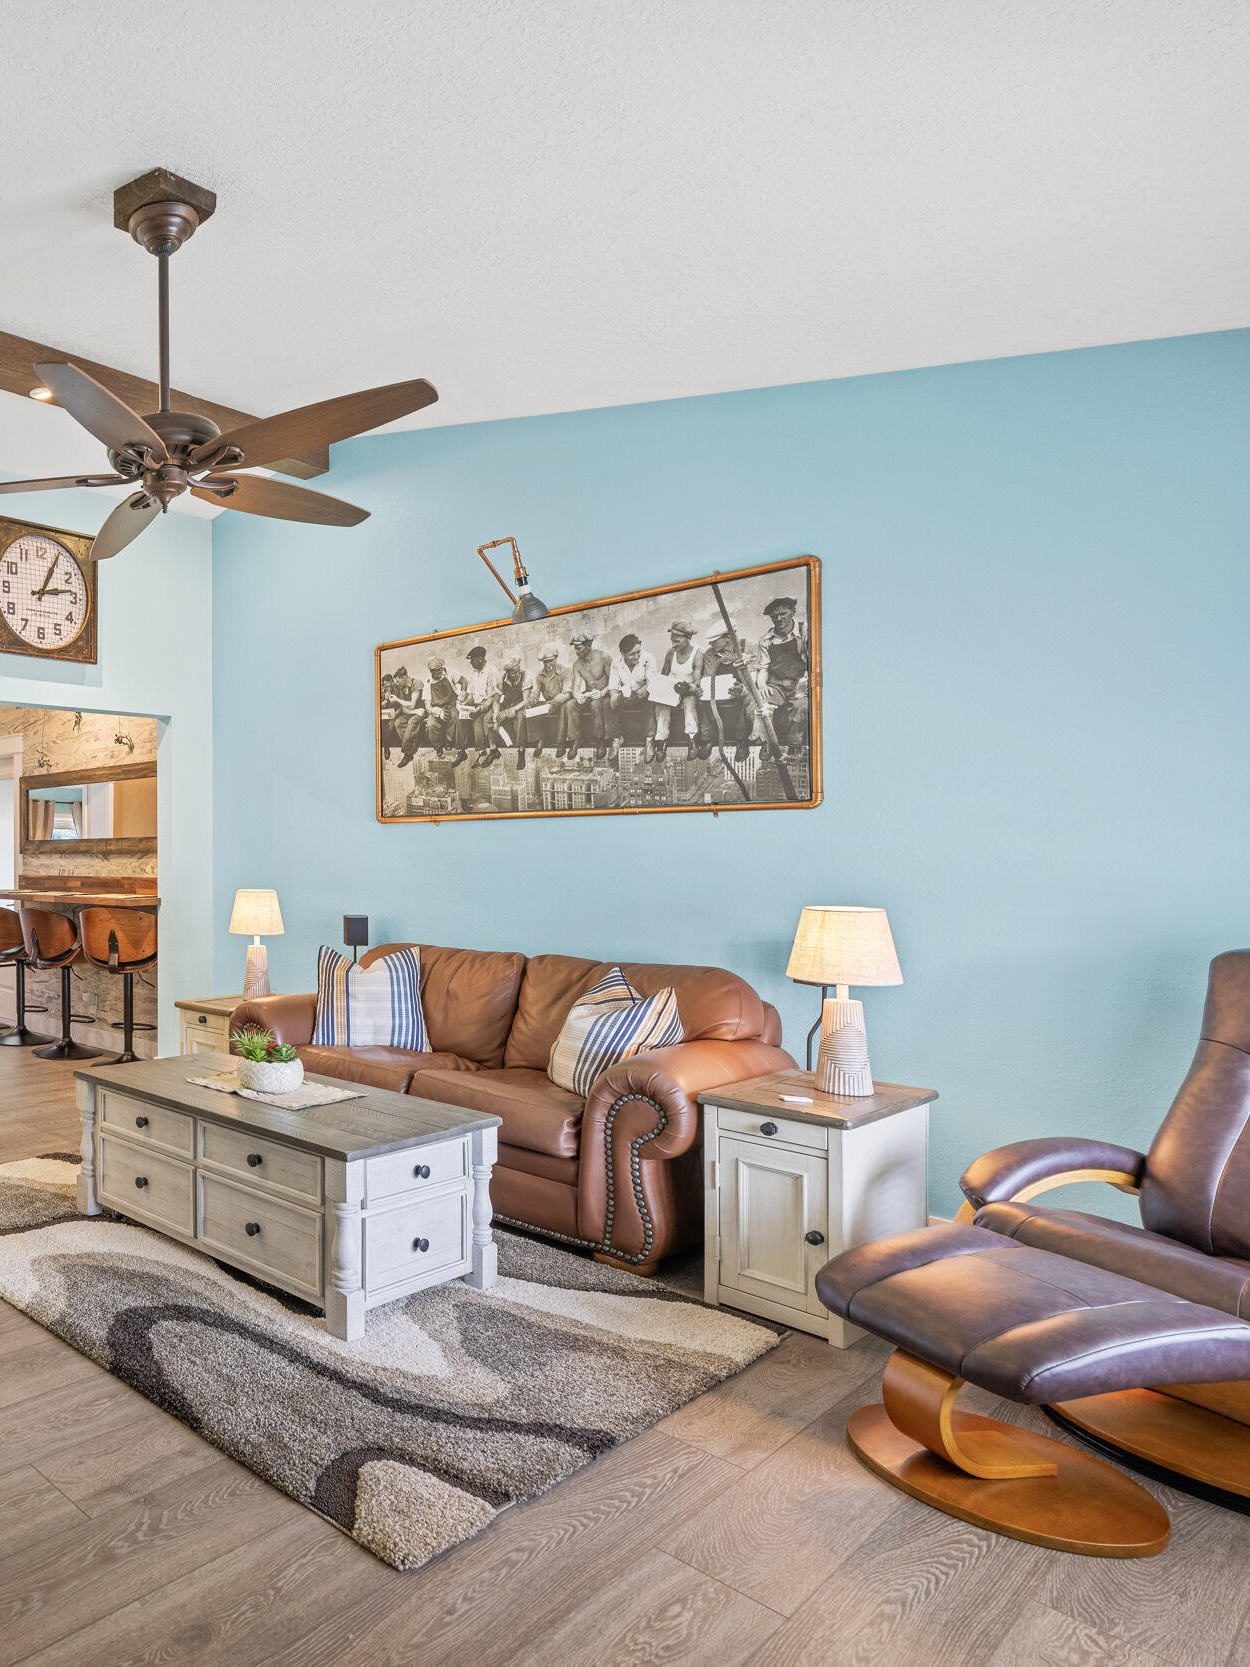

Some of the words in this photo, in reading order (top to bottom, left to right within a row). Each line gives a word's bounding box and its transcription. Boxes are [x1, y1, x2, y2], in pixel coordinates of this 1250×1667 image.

[19, 547, 28, 562] 11
[36, 545, 47, 560] 12
[6, 561, 18, 575] 10
[65, 572, 72, 584] 2
[2, 580, 10, 593] 9
[70, 591, 78, 605] 3
[7, 601, 15, 615] 8
[21, 618, 29, 631] 7
[65, 611, 74, 624] 4
[37, 626, 45, 640] 6
[54, 623, 62, 636] 5
